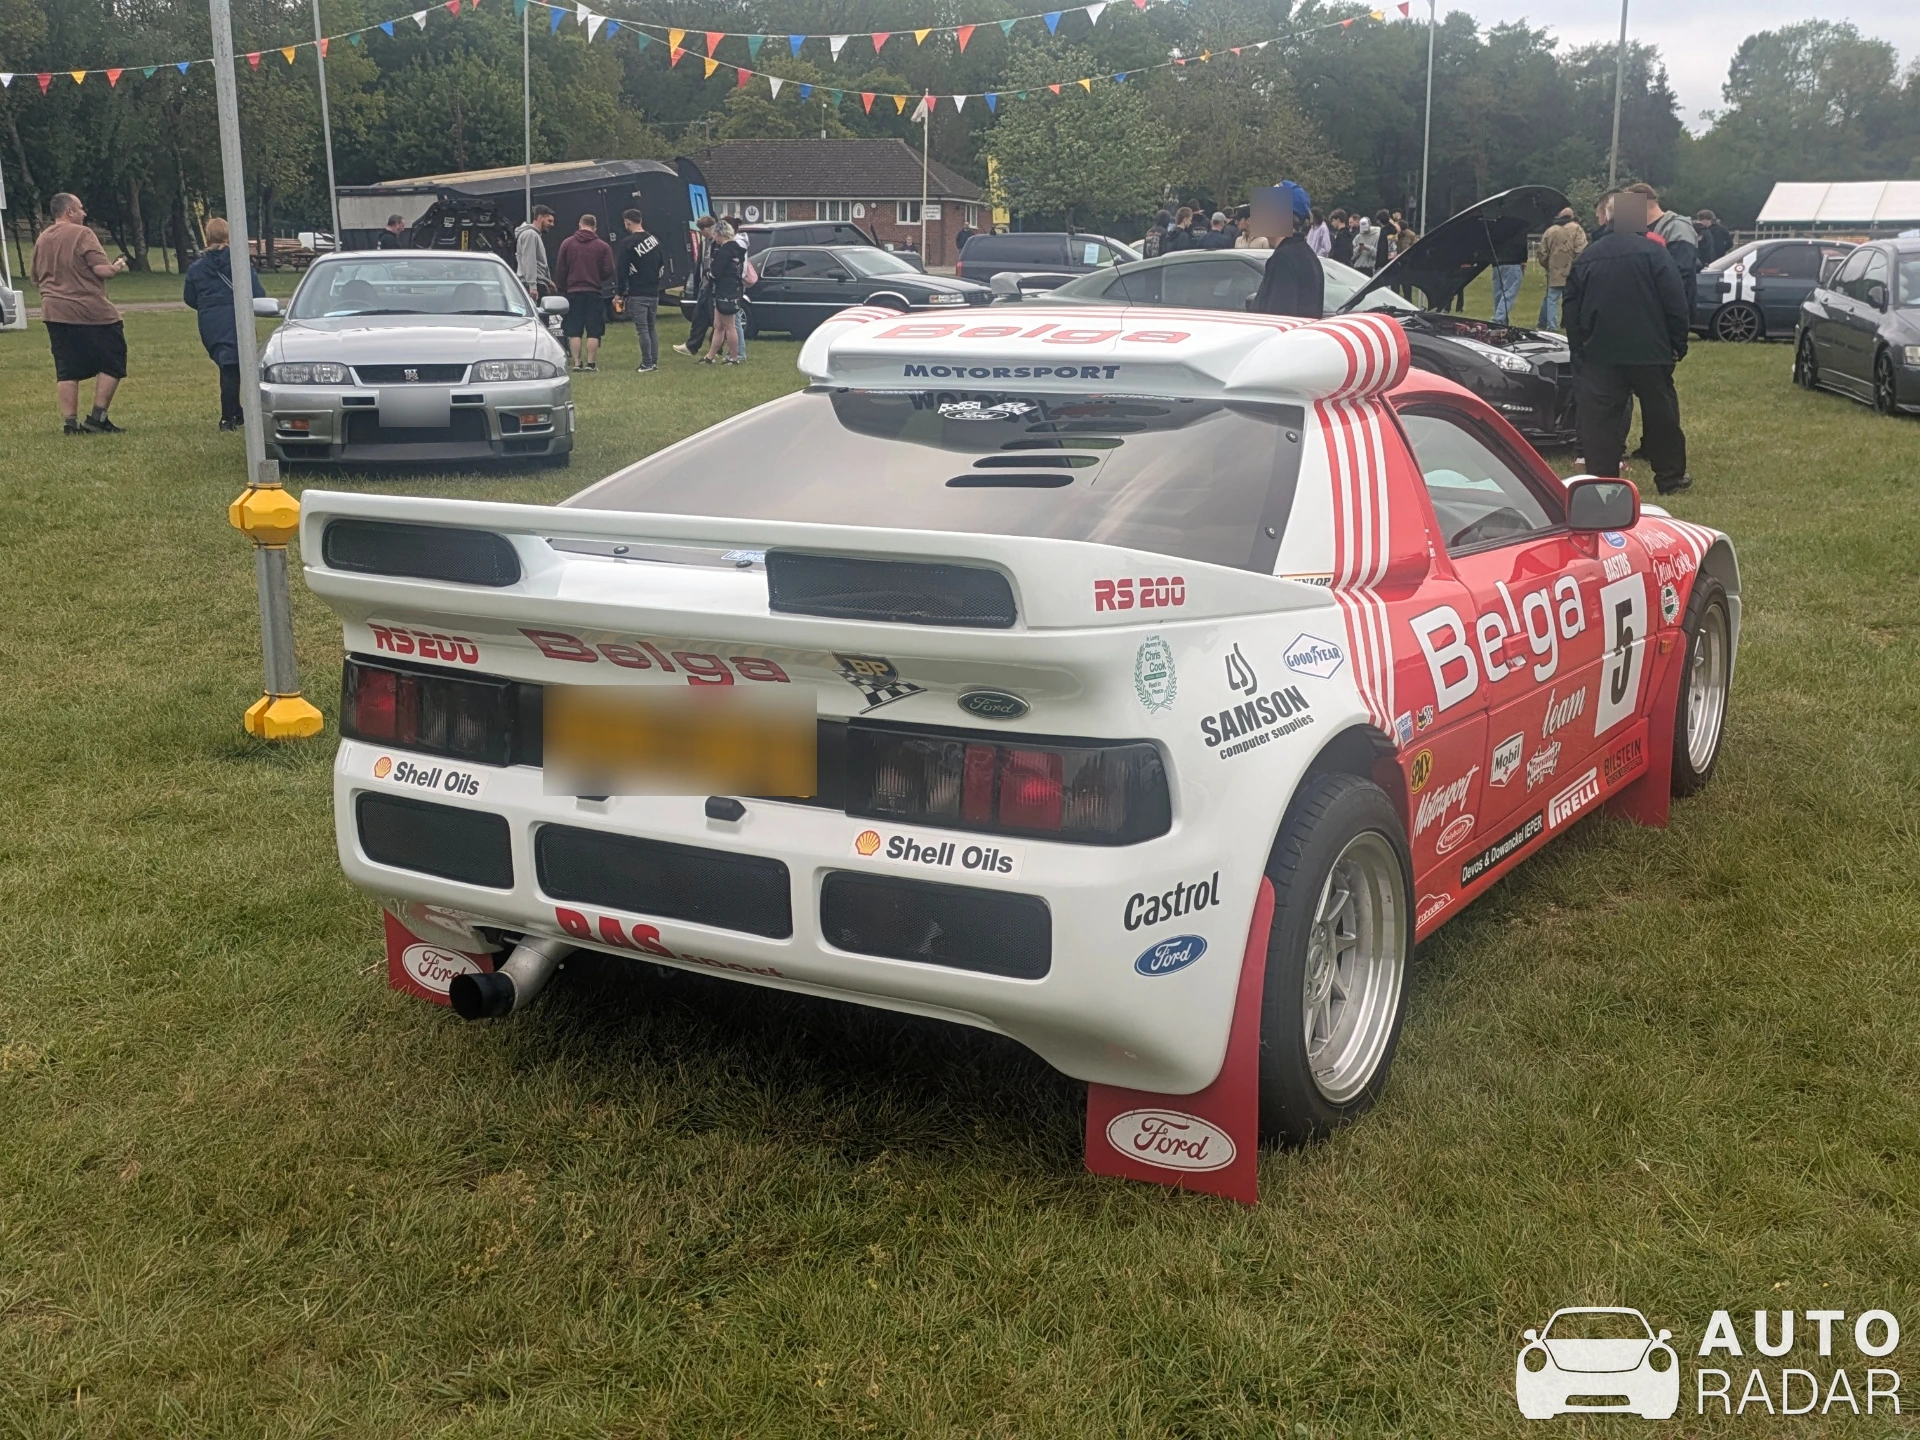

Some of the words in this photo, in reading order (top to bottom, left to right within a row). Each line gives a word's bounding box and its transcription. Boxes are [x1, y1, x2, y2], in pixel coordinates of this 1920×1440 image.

[634, 234, 659, 257] KLEIN
[872, 323, 1191, 344] Belga
[903, 364, 1121, 379] MOTORSPORT
[1603, 552, 1632, 582] BASTOS
[1094, 579, 1135, 611] RS
[1139, 576, 1185, 608] 200
[366, 622, 415, 654] RS
[410, 629, 479, 665] 200
[517, 628, 790, 685] Belga
[1145, 650, 1161, 661] Chris
[1409, 575, 1587, 713] Belga
[1611, 598, 1633, 705] 5
[845, 659, 889, 677] BP
[1150, 660, 1166, 672] Cook
[969, 697, 1014, 713] Ford
[1200, 685, 1310, 747] SAMSON
[1542, 686, 1586, 739] team
[1220, 732, 1271, 760] computer
[1271, 714, 1315, 739] supplies
[1411, 754, 1431, 788] SPAX
[1494, 744, 1520, 773] Mobil
[1604, 737, 1641, 777] BILSTEIN
[393, 761, 442, 789] Shell
[444, 771, 480, 796] Oils
[1548, 767, 1600, 829] PIRELLI
[1411, 764, 1479, 849] Motorsport
[885, 835, 956, 867] Shell
[961, 845, 1014, 874] Oils
[1462, 859, 1484, 882] Devos
[1484, 851, 1490, 867] &
[1491, 828, 1524, 863] Dowanckel
[1524, 814, 1543, 840] IEPER
[1123, 871, 1220, 931] Castrol
[555, 907, 677, 959] RAS
[1150, 940, 1193, 971] Ford
[1134, 1117, 1210, 1160] Ford
